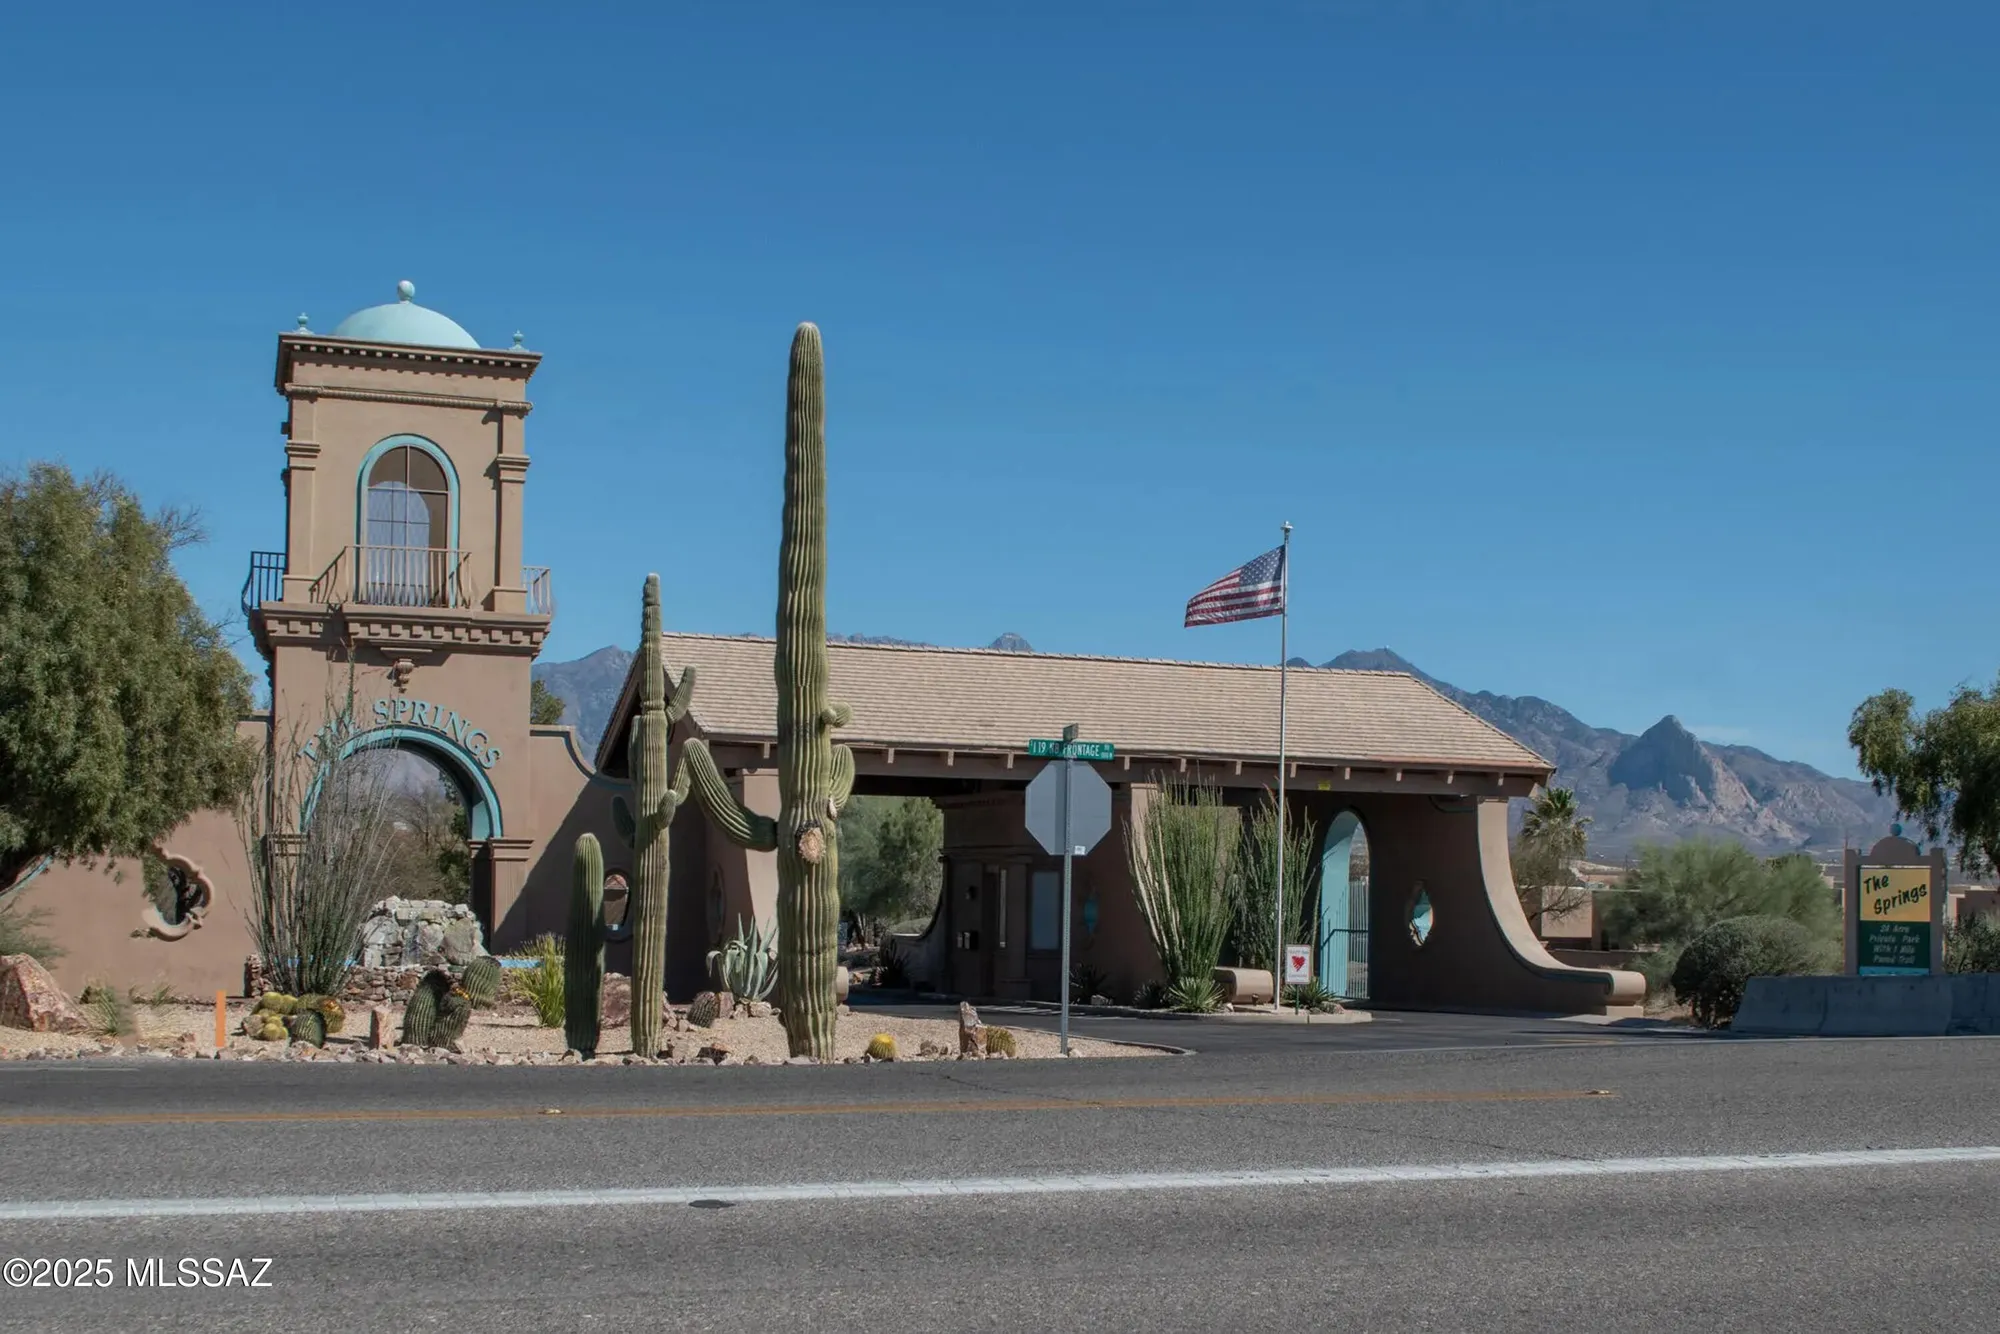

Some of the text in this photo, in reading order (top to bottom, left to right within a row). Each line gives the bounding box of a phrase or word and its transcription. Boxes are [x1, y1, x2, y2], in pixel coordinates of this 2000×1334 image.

[372, 698, 504, 770] SPRINGS
[1038, 741, 1047, 753] 19
[1063, 743, 1100, 757] FRONTAGE
[1864, 875, 1889, 894] The
[1873, 883, 1927, 915] Springs
[1868, 934, 1920, 943] Private Park
